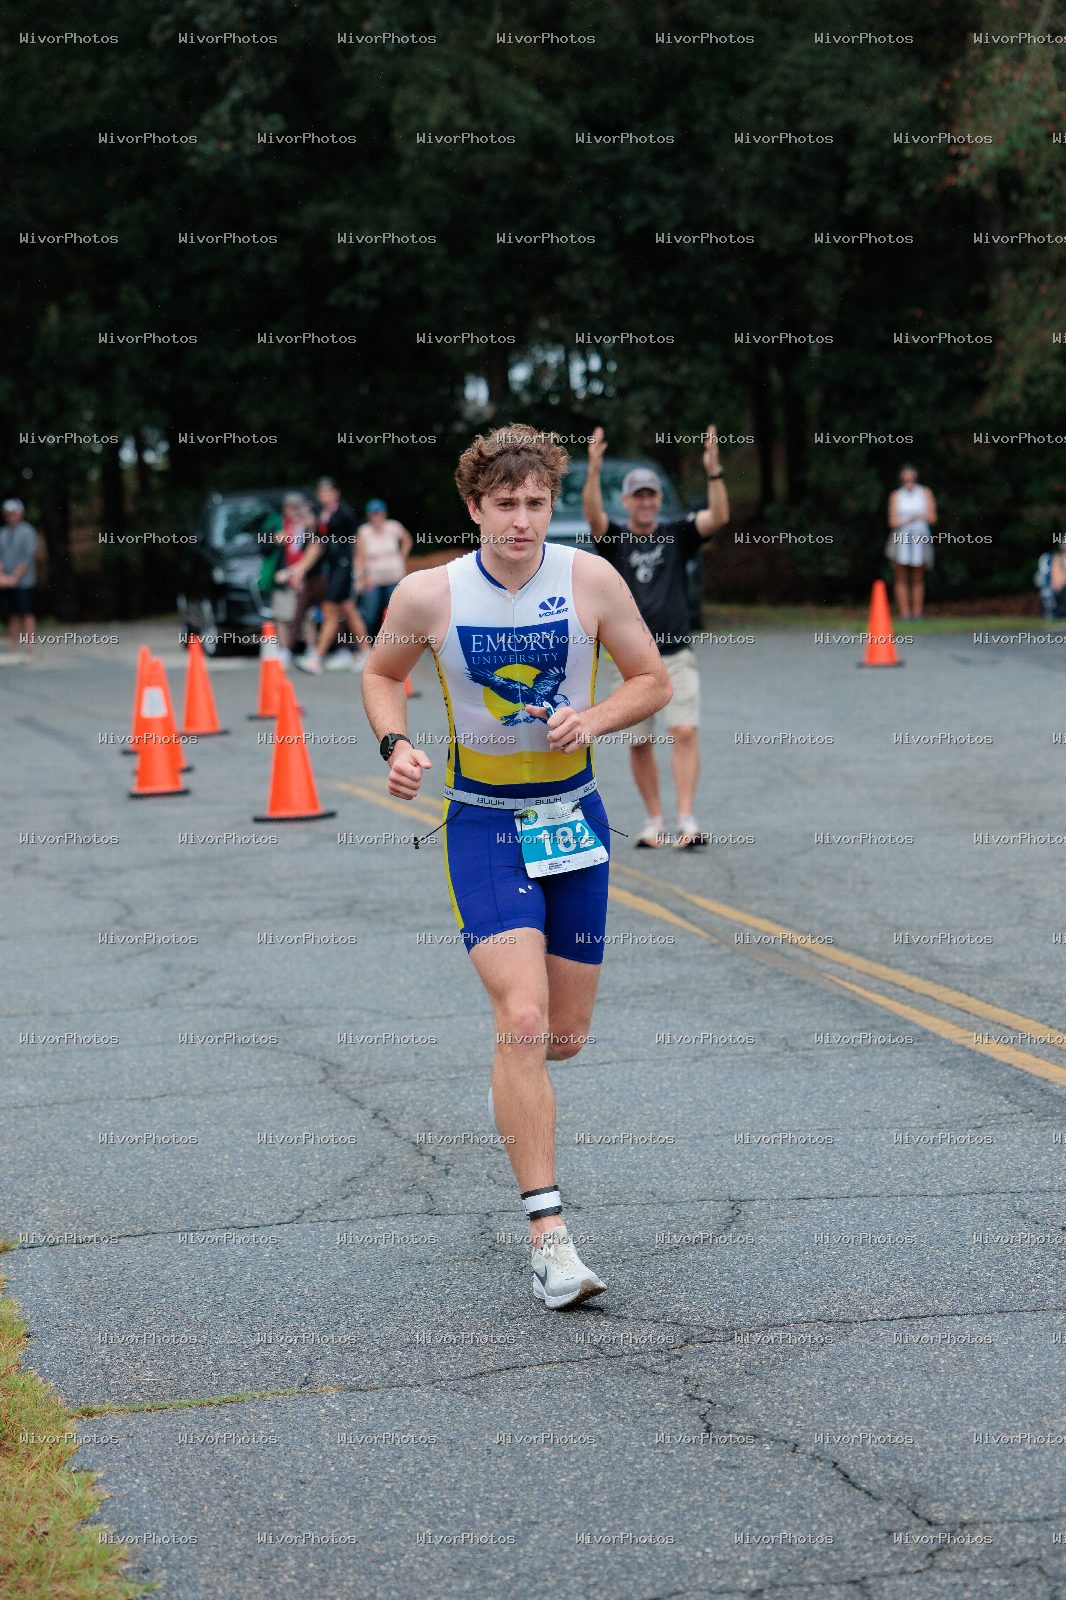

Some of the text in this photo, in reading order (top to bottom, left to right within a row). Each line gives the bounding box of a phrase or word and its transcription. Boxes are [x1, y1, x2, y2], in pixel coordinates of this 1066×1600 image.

[470, 629, 556, 653] EMORY
[471, 652, 559, 665] UNIVERSITY
[537, 822, 595, 856] 182
